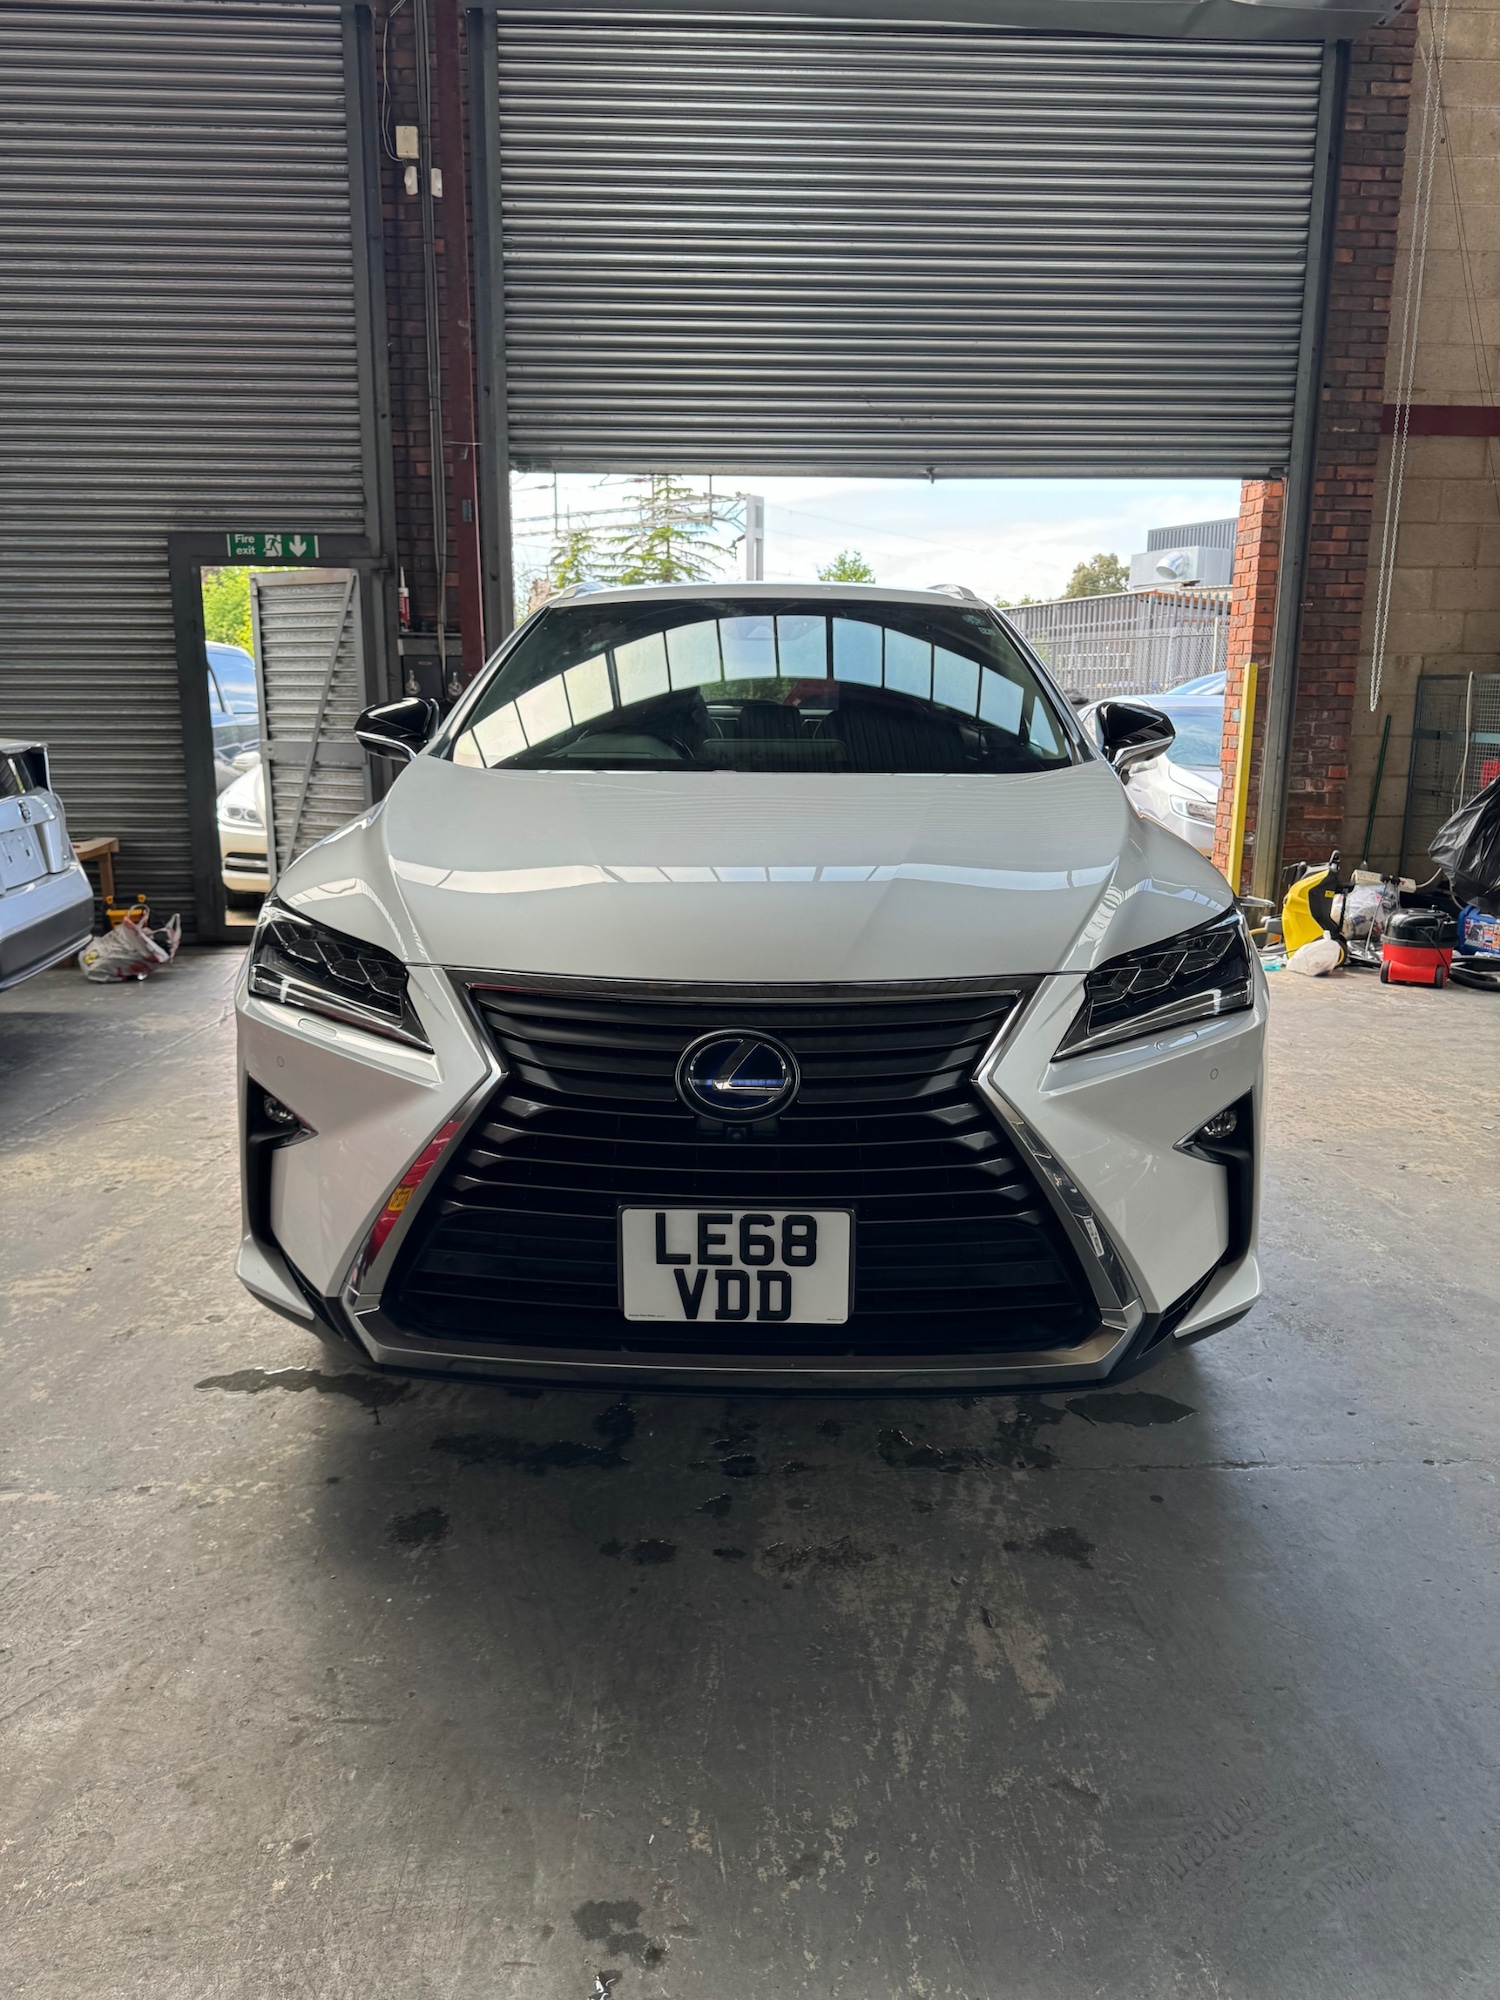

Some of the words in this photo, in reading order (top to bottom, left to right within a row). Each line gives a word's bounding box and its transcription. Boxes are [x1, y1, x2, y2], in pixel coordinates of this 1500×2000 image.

[234, 533, 255, 544] Fire
[236, 545, 256, 555] exit
[655, 1212, 818, 1267] LE68
[673, 1268, 792, 1321] VDD
